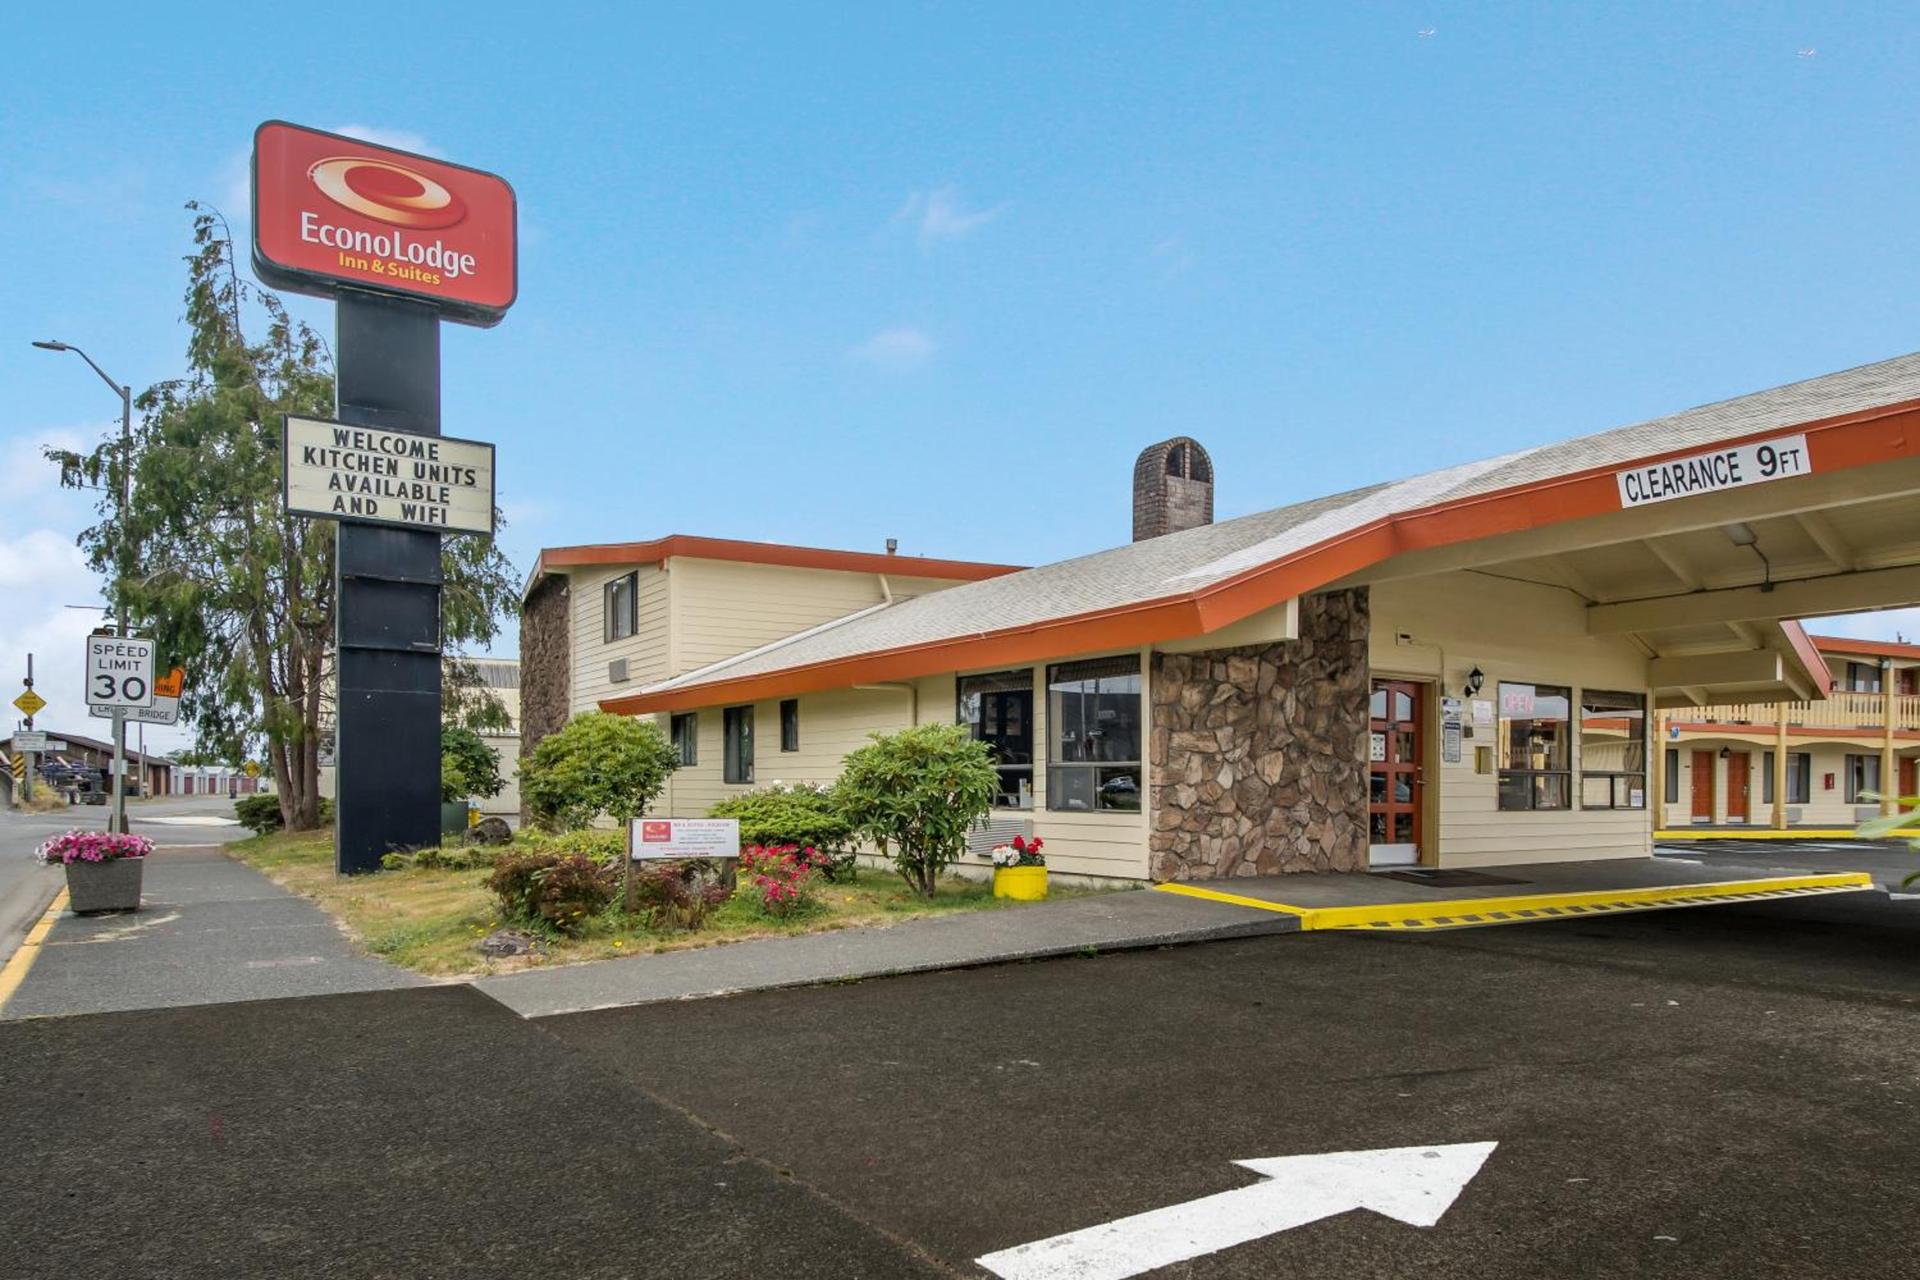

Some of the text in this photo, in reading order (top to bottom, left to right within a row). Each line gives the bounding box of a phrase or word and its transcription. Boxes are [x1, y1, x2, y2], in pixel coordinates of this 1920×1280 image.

[301, 211, 476, 278] EconoLodge
[338, 252, 441, 285] Inn & Suites
[333, 428, 439, 461] WELCOME
[304, 446, 476, 486] KITCHEN UNITS
[1625, 452, 1743, 503] CLEARANCE
[328, 472, 450, 504] AVAILABLE
[332, 495, 447, 525] AND WIFI
[93, 644, 148, 658] SPEED
[98, 659, 142, 671] LIMIT
[93, 674, 146, 701] 30
[138, 709, 171, 720] BRIDGE
